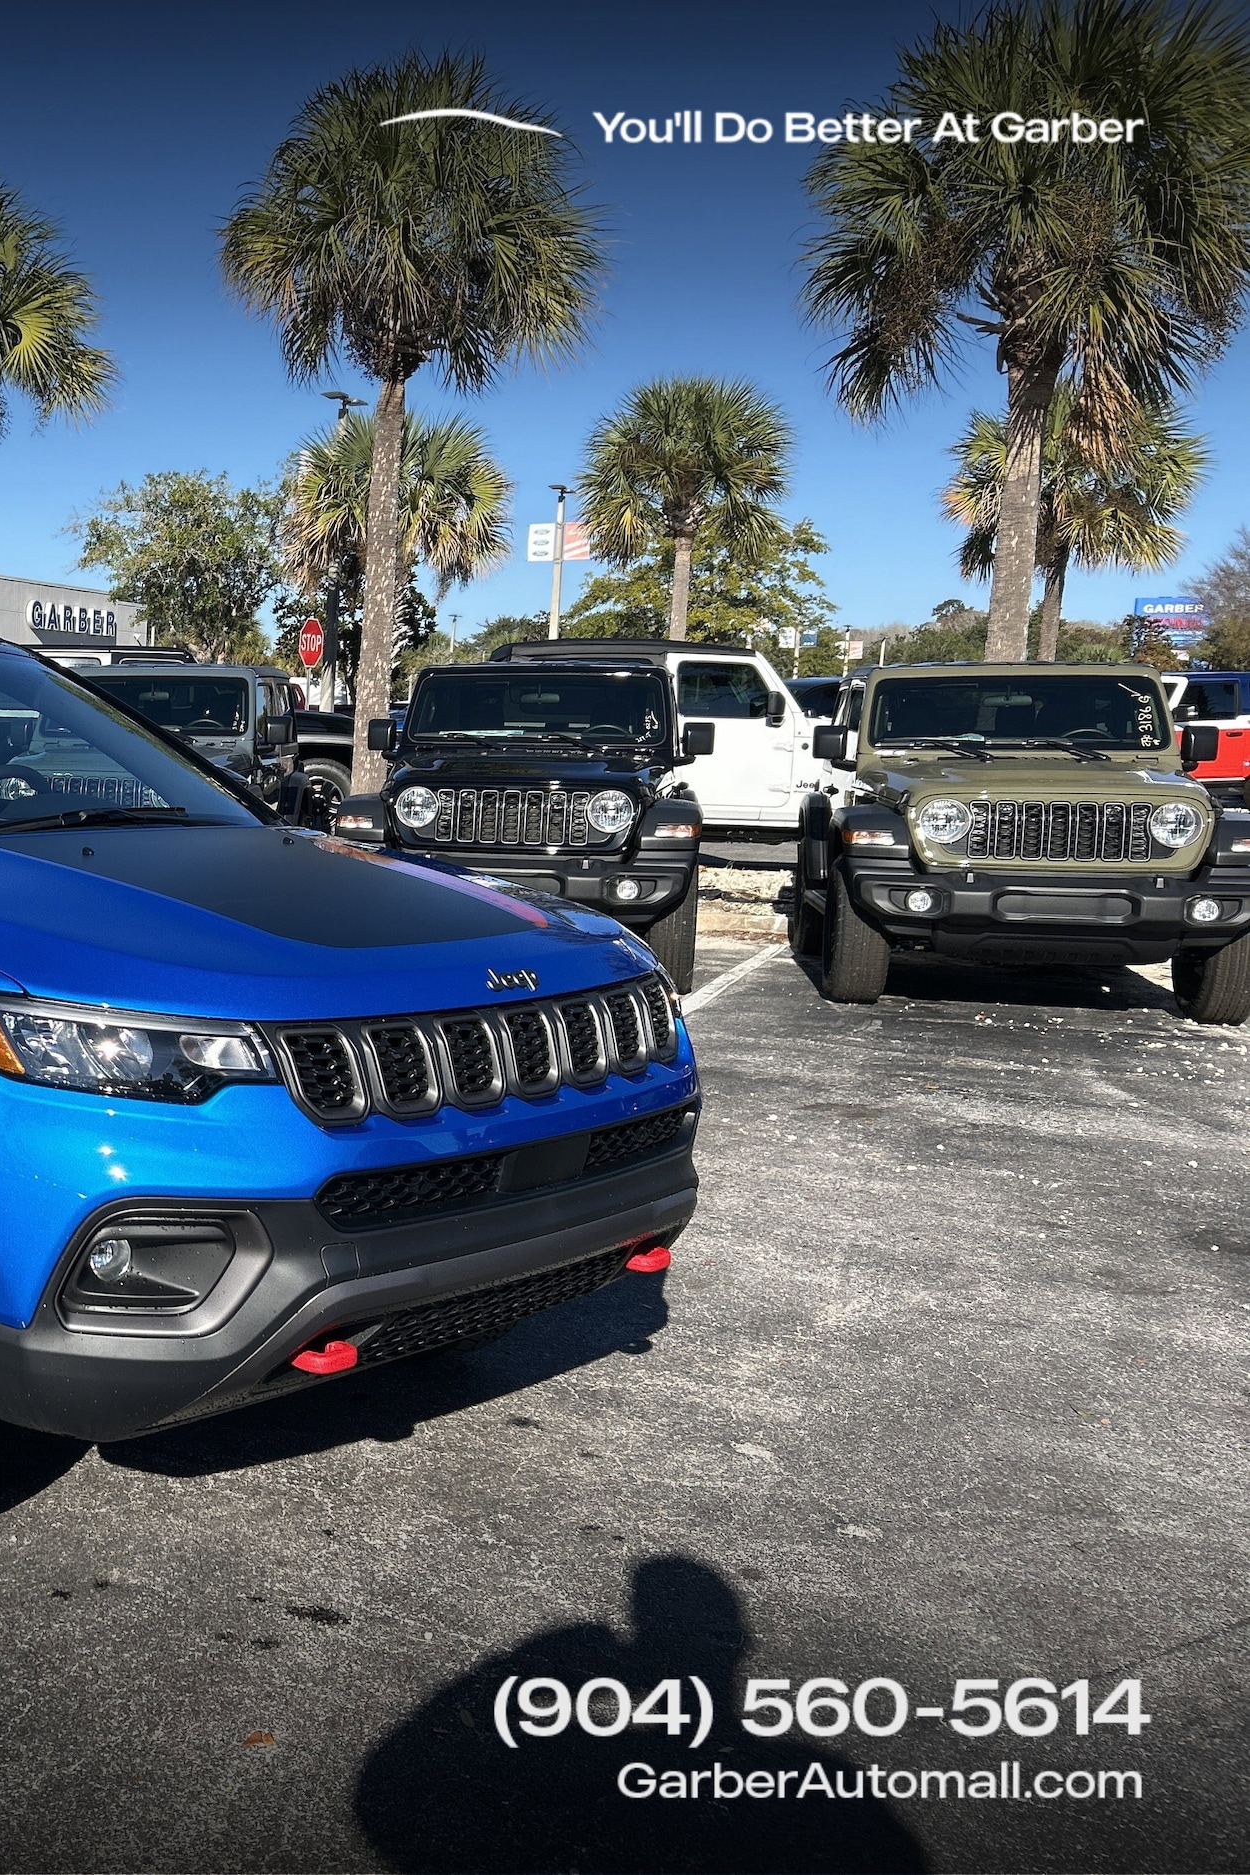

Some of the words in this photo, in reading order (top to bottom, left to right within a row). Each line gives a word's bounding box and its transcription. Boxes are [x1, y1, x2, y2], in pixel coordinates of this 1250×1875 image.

[26, 599, 117, 637] GARBER
[1142, 603, 1205, 615] GARBER
[301, 633, 322, 652] STOP
[1137, 705, 1153, 733] 3186
[795, 779, 816, 789] Jee
[486, 966, 540, 992] Jeep
